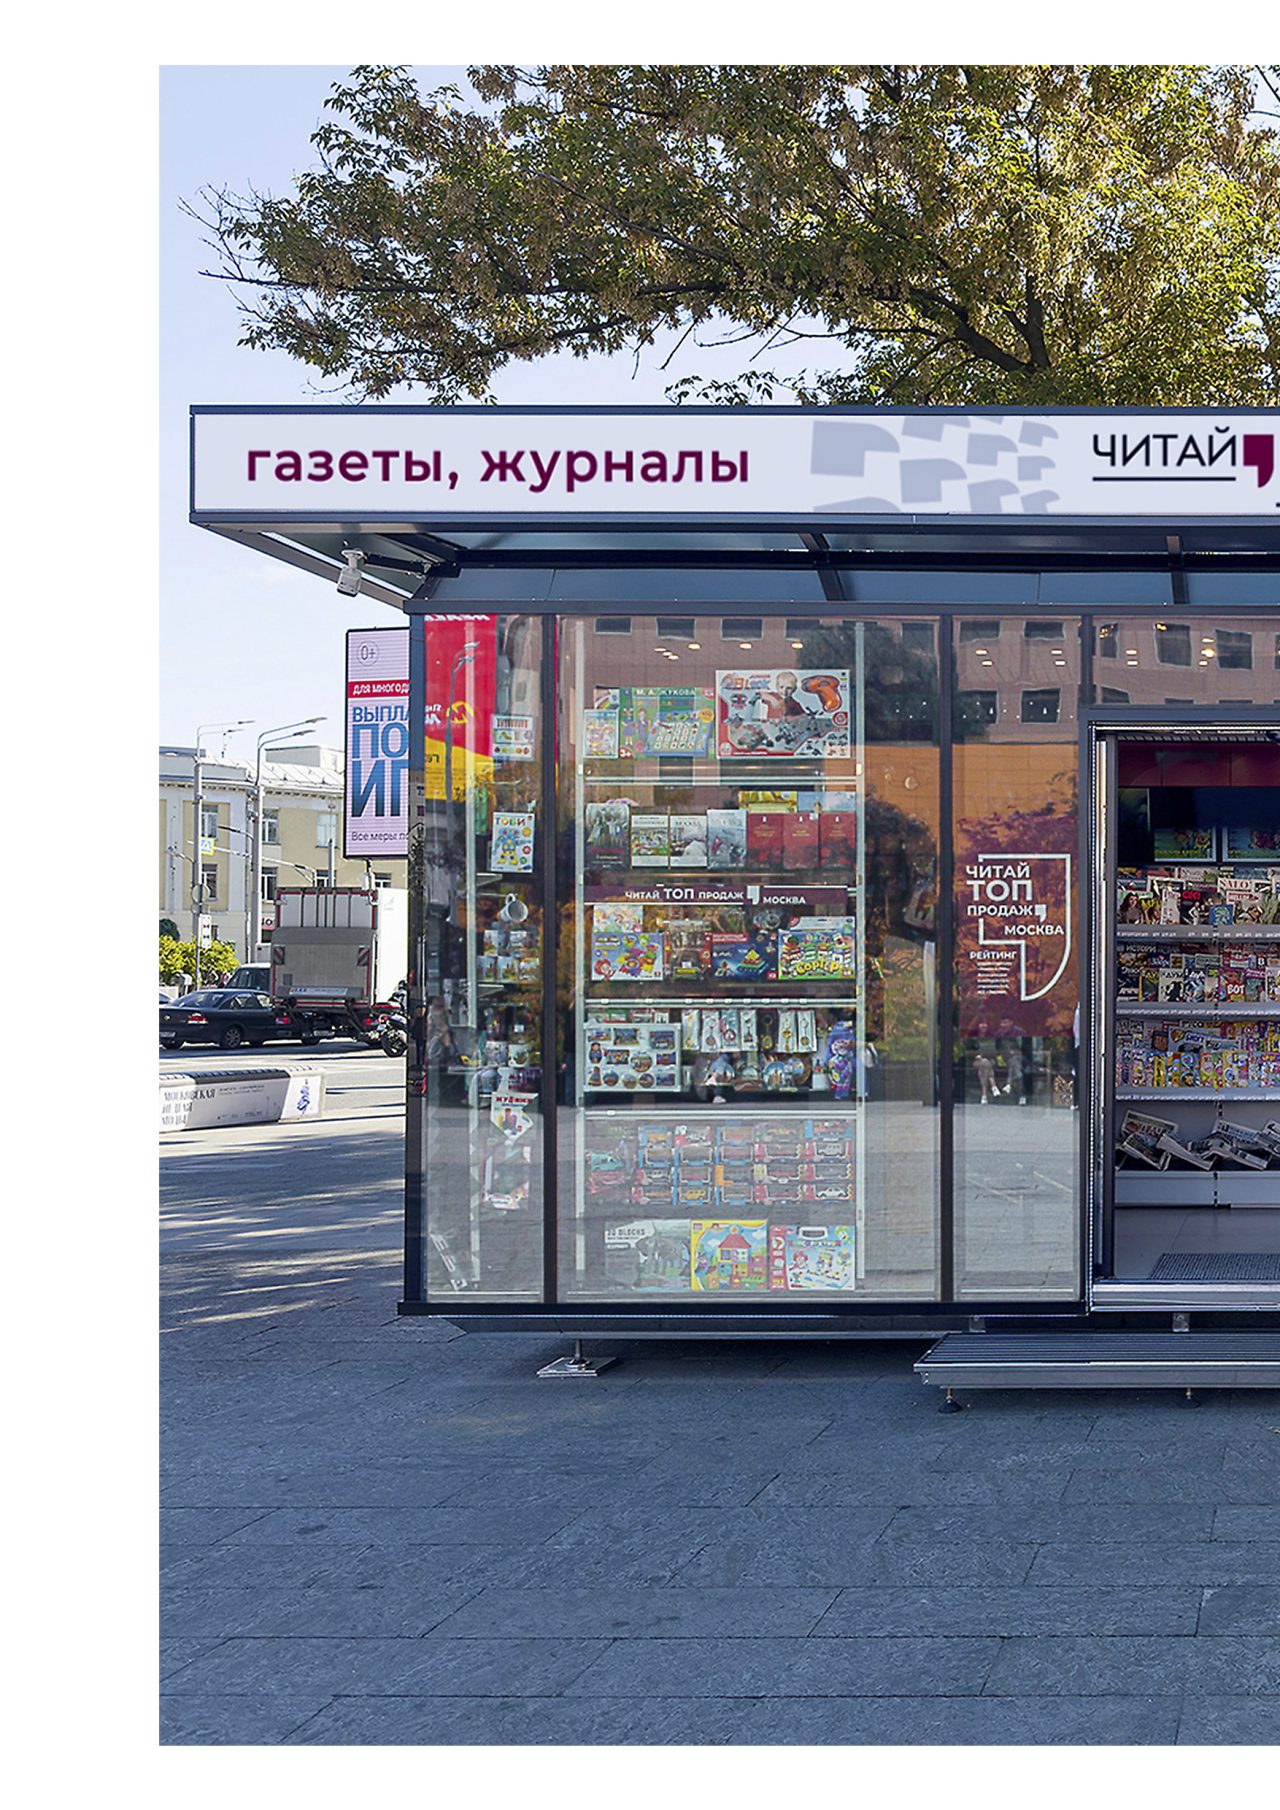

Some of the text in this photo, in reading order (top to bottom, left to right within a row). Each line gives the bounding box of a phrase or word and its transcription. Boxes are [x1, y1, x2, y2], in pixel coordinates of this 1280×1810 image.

[1092, 426, 1236, 466] ЧИТАЙ
[247, 450, 749, 492] газеты, журналы
[353, 684, 371, 696] ДЛЯ
[966, 862, 1030, 878] ЧИТАЙ
[625, 888, 743, 900] ЧИТАЙ ТОП ПРОДАЖ
[966, 880, 1032, 902] ТОП
[763, 896, 806, 904] МОСКВА
[967, 905, 1033, 917] ПРОДАЖ
[1004, 925, 1064, 935] МОСКВА
[969, 950, 1017, 960] РЕЙТИНГ
